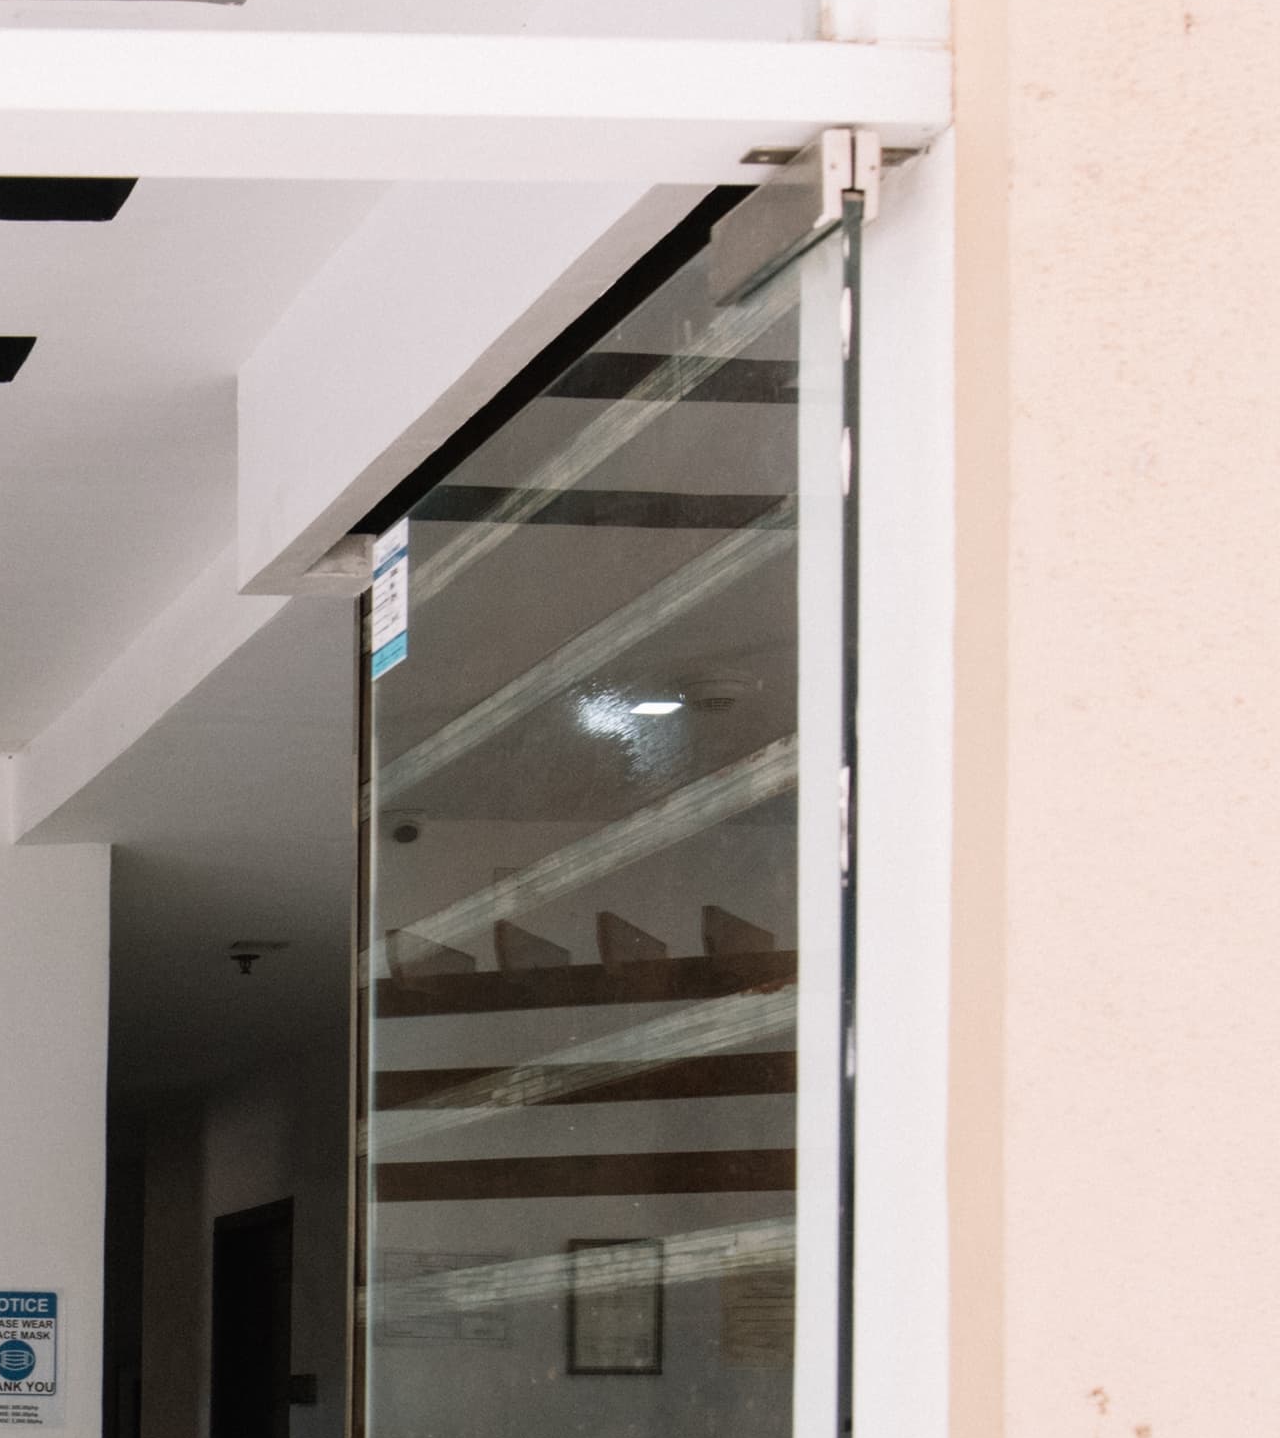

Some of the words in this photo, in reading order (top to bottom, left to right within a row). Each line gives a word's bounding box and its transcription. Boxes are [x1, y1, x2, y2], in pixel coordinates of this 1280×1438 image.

[21, 1320, 53, 1329] WEAR
[20, 1331, 50, 1340] MASK
[26, 1382, 55, 1393] YOU
